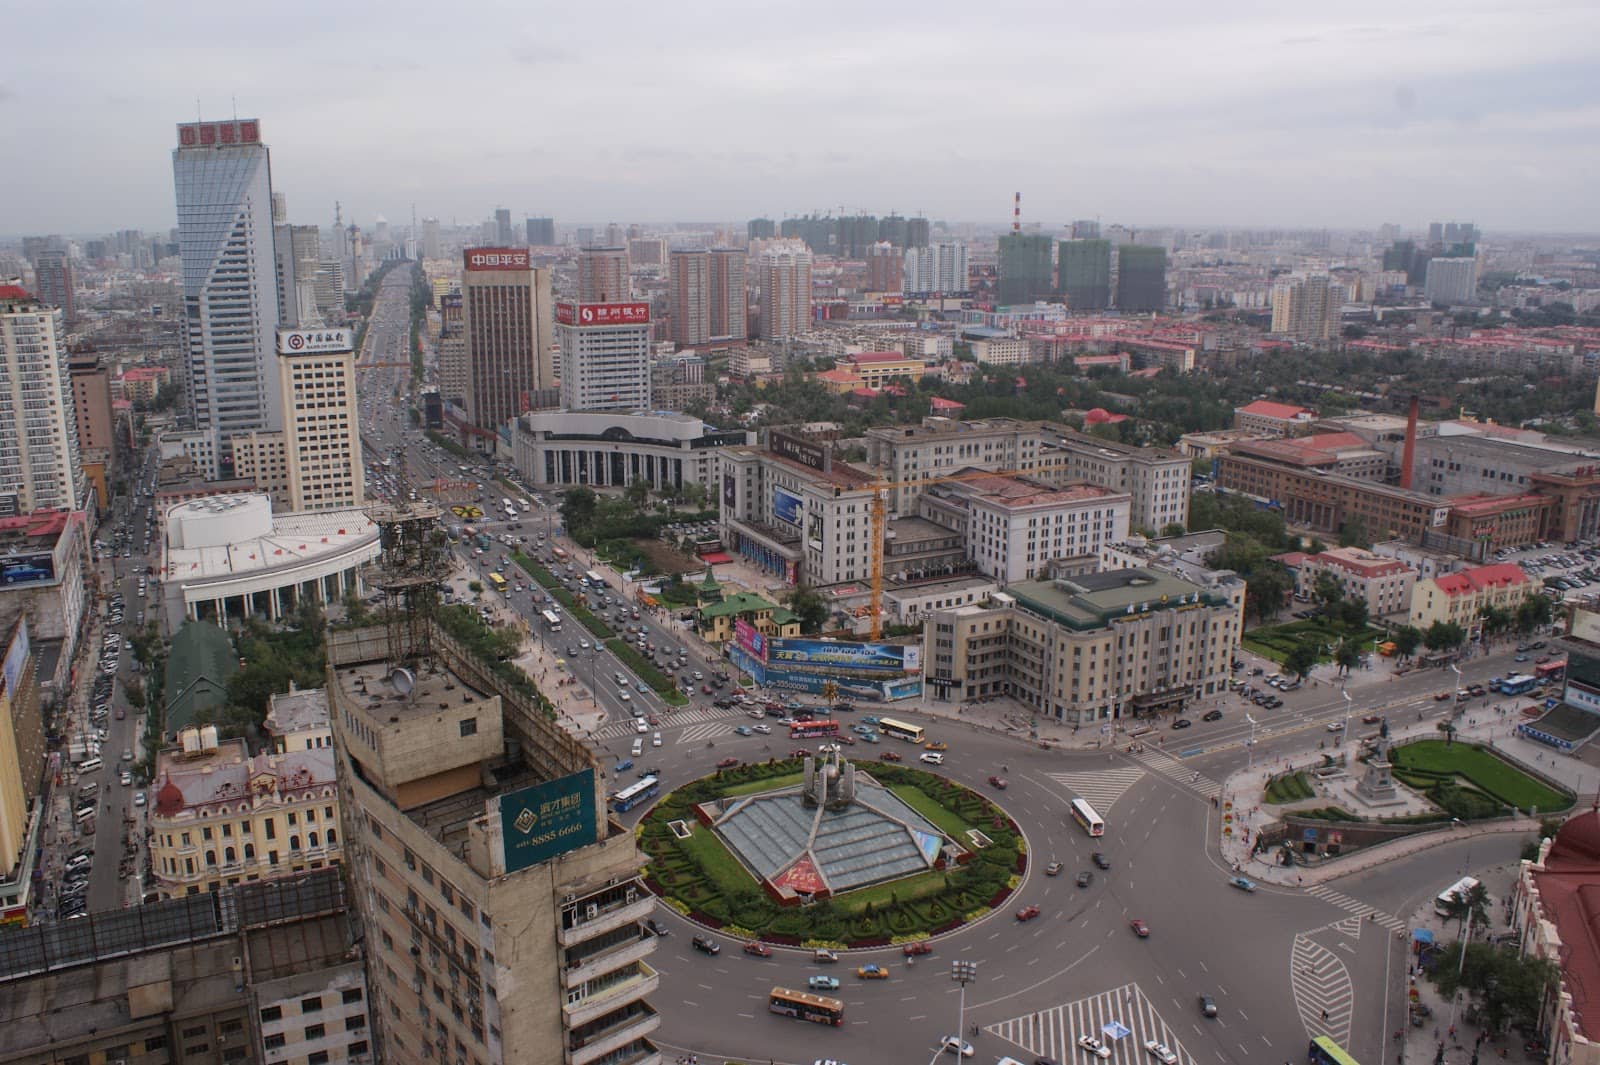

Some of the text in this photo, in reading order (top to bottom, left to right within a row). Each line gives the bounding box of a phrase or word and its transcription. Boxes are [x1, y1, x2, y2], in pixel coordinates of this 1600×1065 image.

[472, 254, 526, 266] 中国平安
[306, 333, 344, 344] 中国银行
